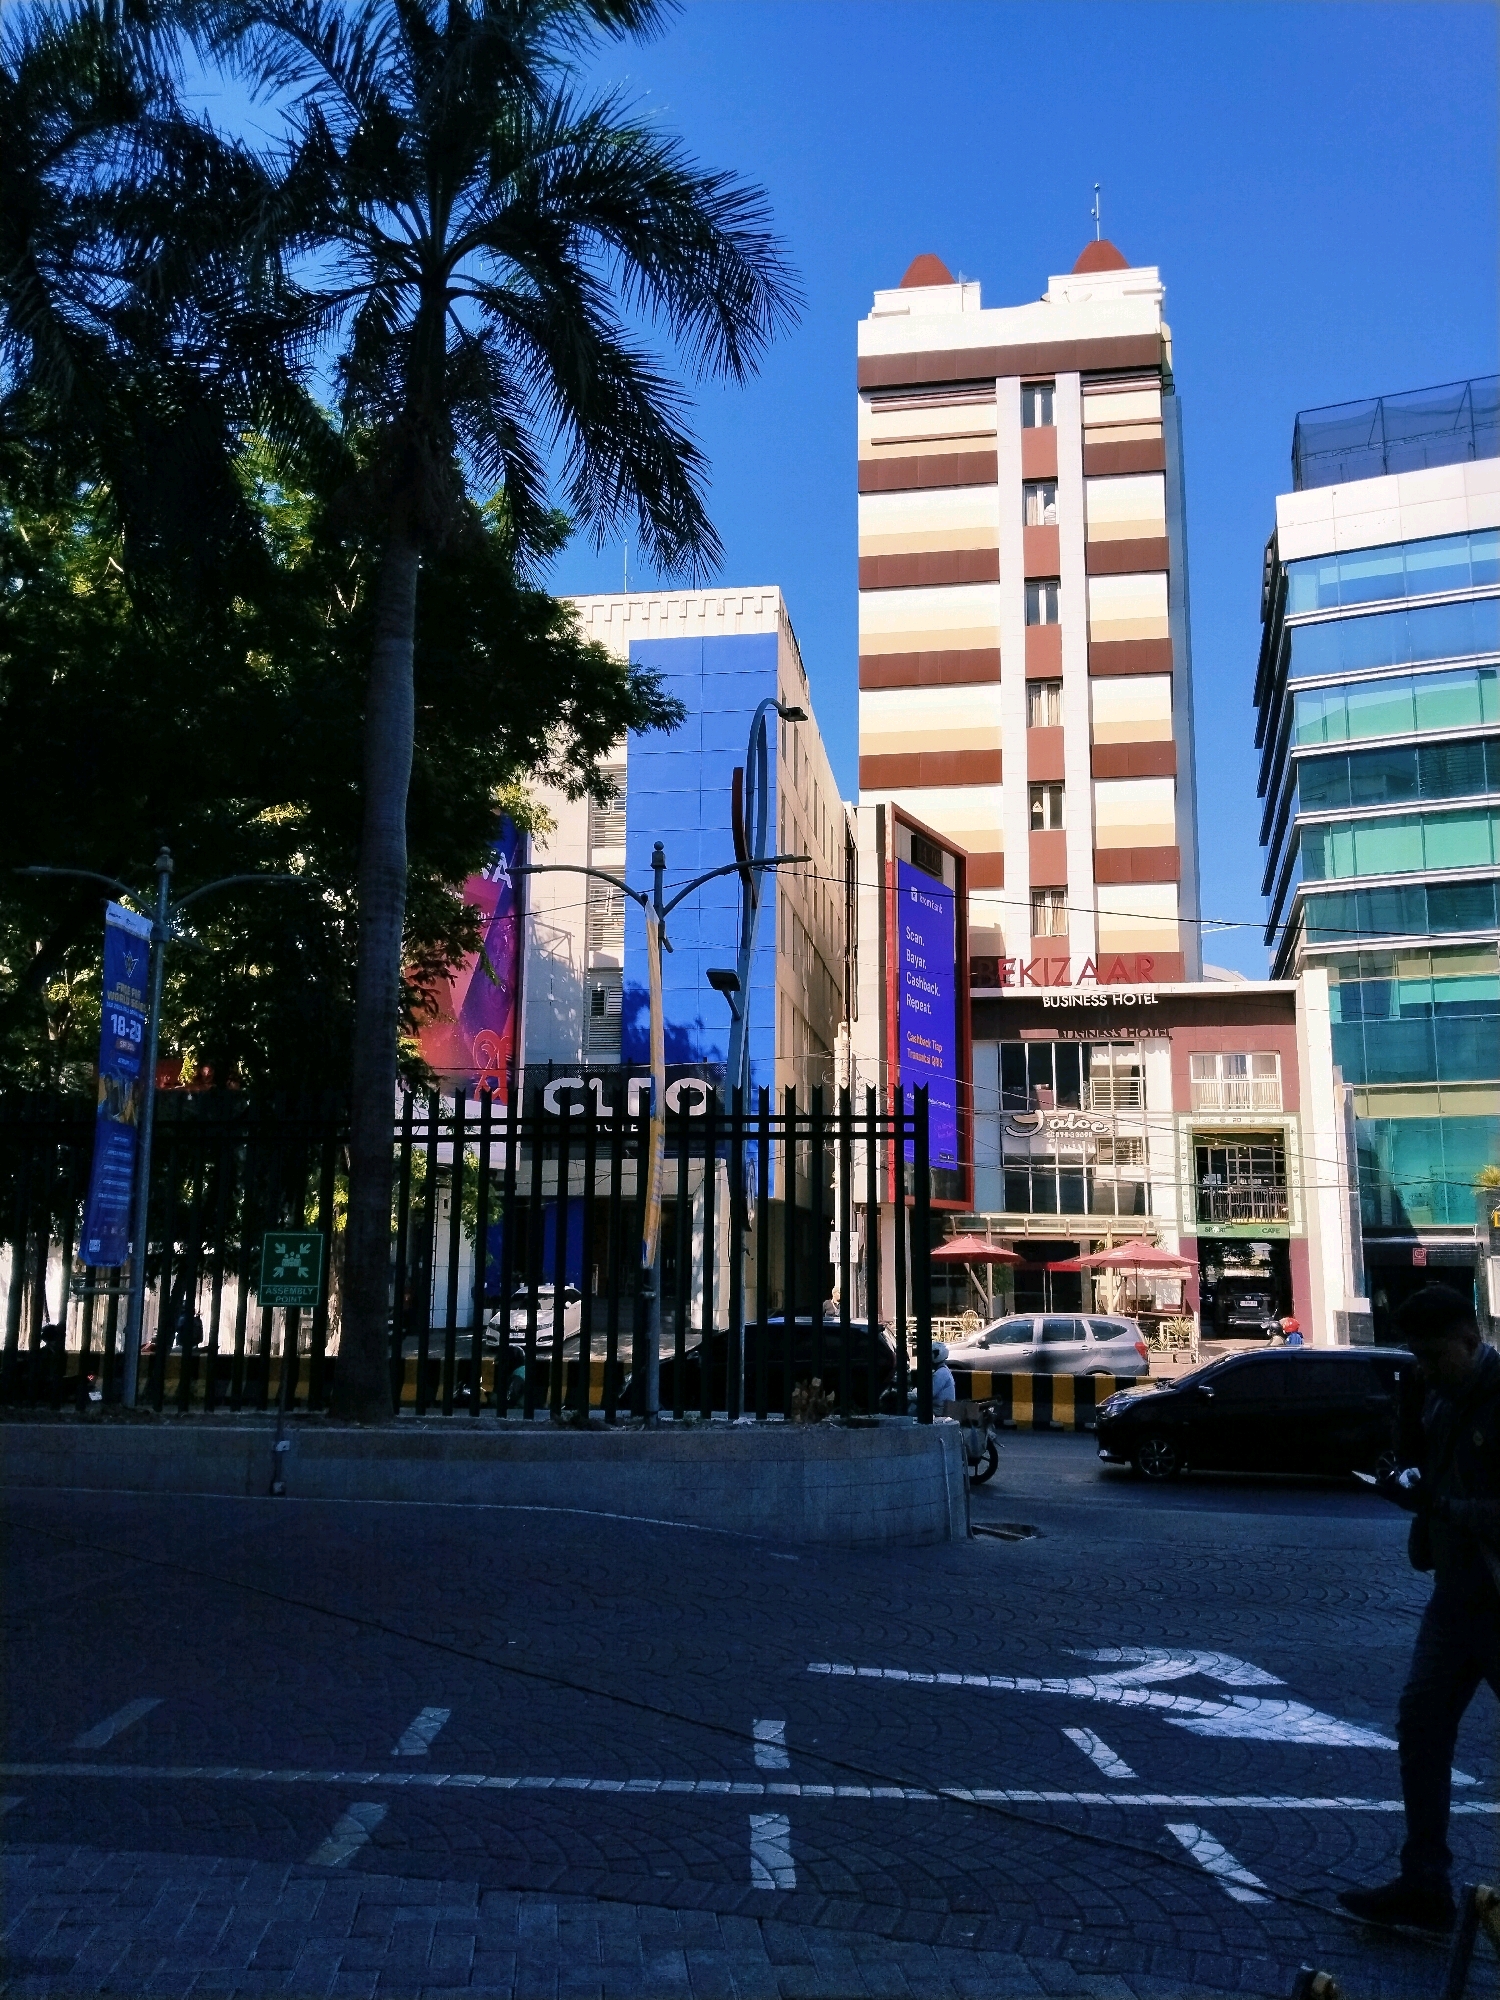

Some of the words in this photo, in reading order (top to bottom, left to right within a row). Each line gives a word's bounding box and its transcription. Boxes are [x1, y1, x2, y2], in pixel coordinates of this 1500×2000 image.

[906, 925, 925, 946] Scan.
[906, 948, 927, 969] Bayar.
[906, 971, 941, 997] Cashback.
[906, 992, 932, 1015] Repeat.
[1042, 994, 1108, 1008] BUSINESS
[1112, 993, 1159, 1006] HOTEL
[906, 1030, 931, 1049] Cashback
[265, 1287, 314, 1295] ASSEMBLY
[275, 1295, 303, 1303] POINT
